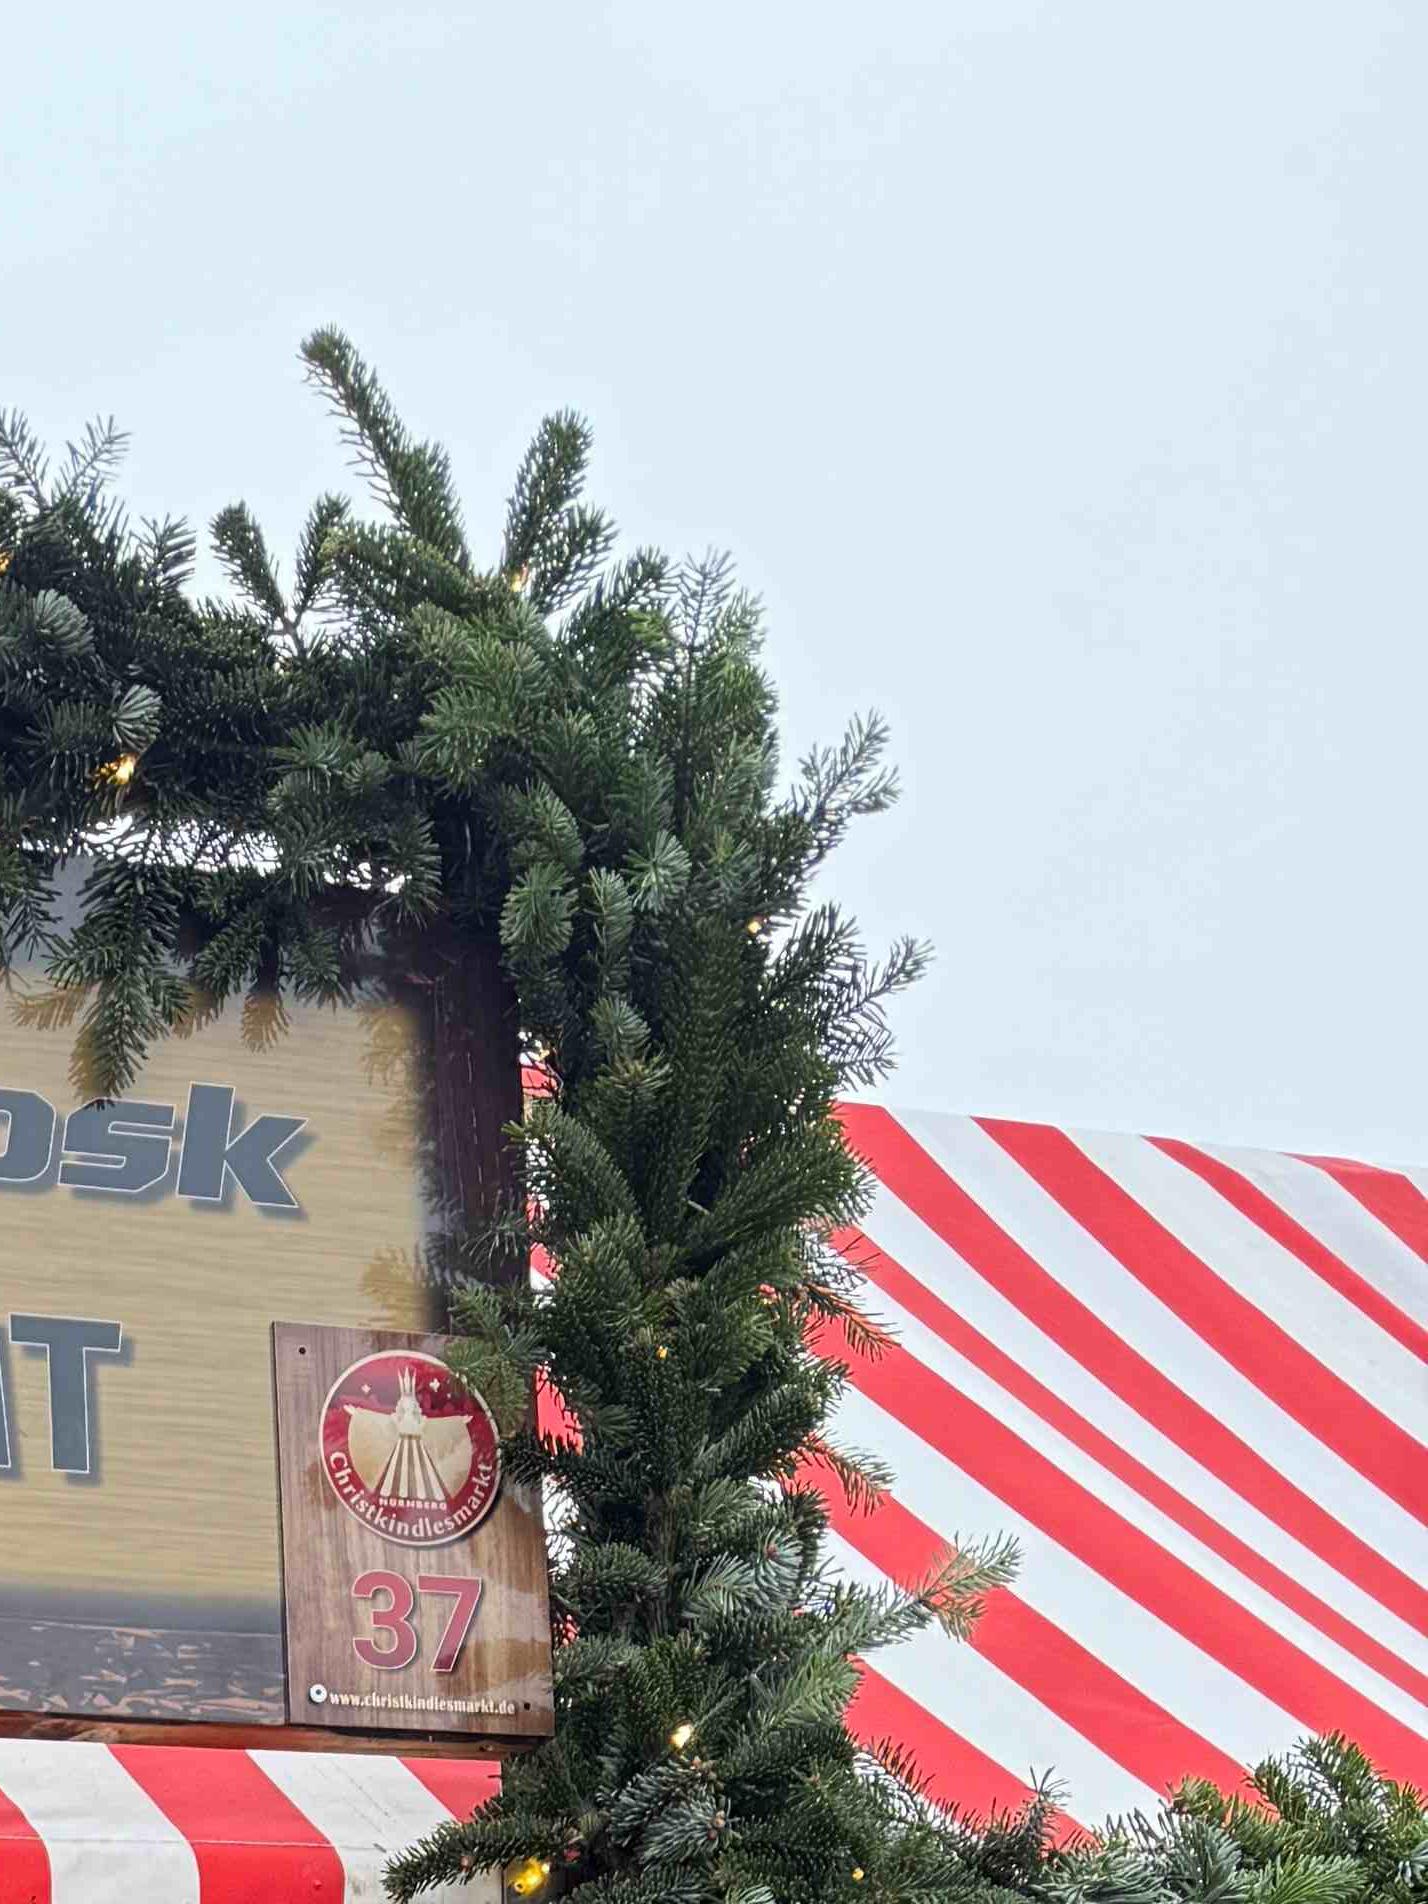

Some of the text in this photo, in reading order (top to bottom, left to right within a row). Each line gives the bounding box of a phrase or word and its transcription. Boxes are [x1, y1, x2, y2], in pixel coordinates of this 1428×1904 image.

[327, 1449, 496, 1538] Christkindlesmarkt
[351, 1568, 483, 1674] 37
[329, 1688, 516, 1716] www.christkindlesmarkt.de
